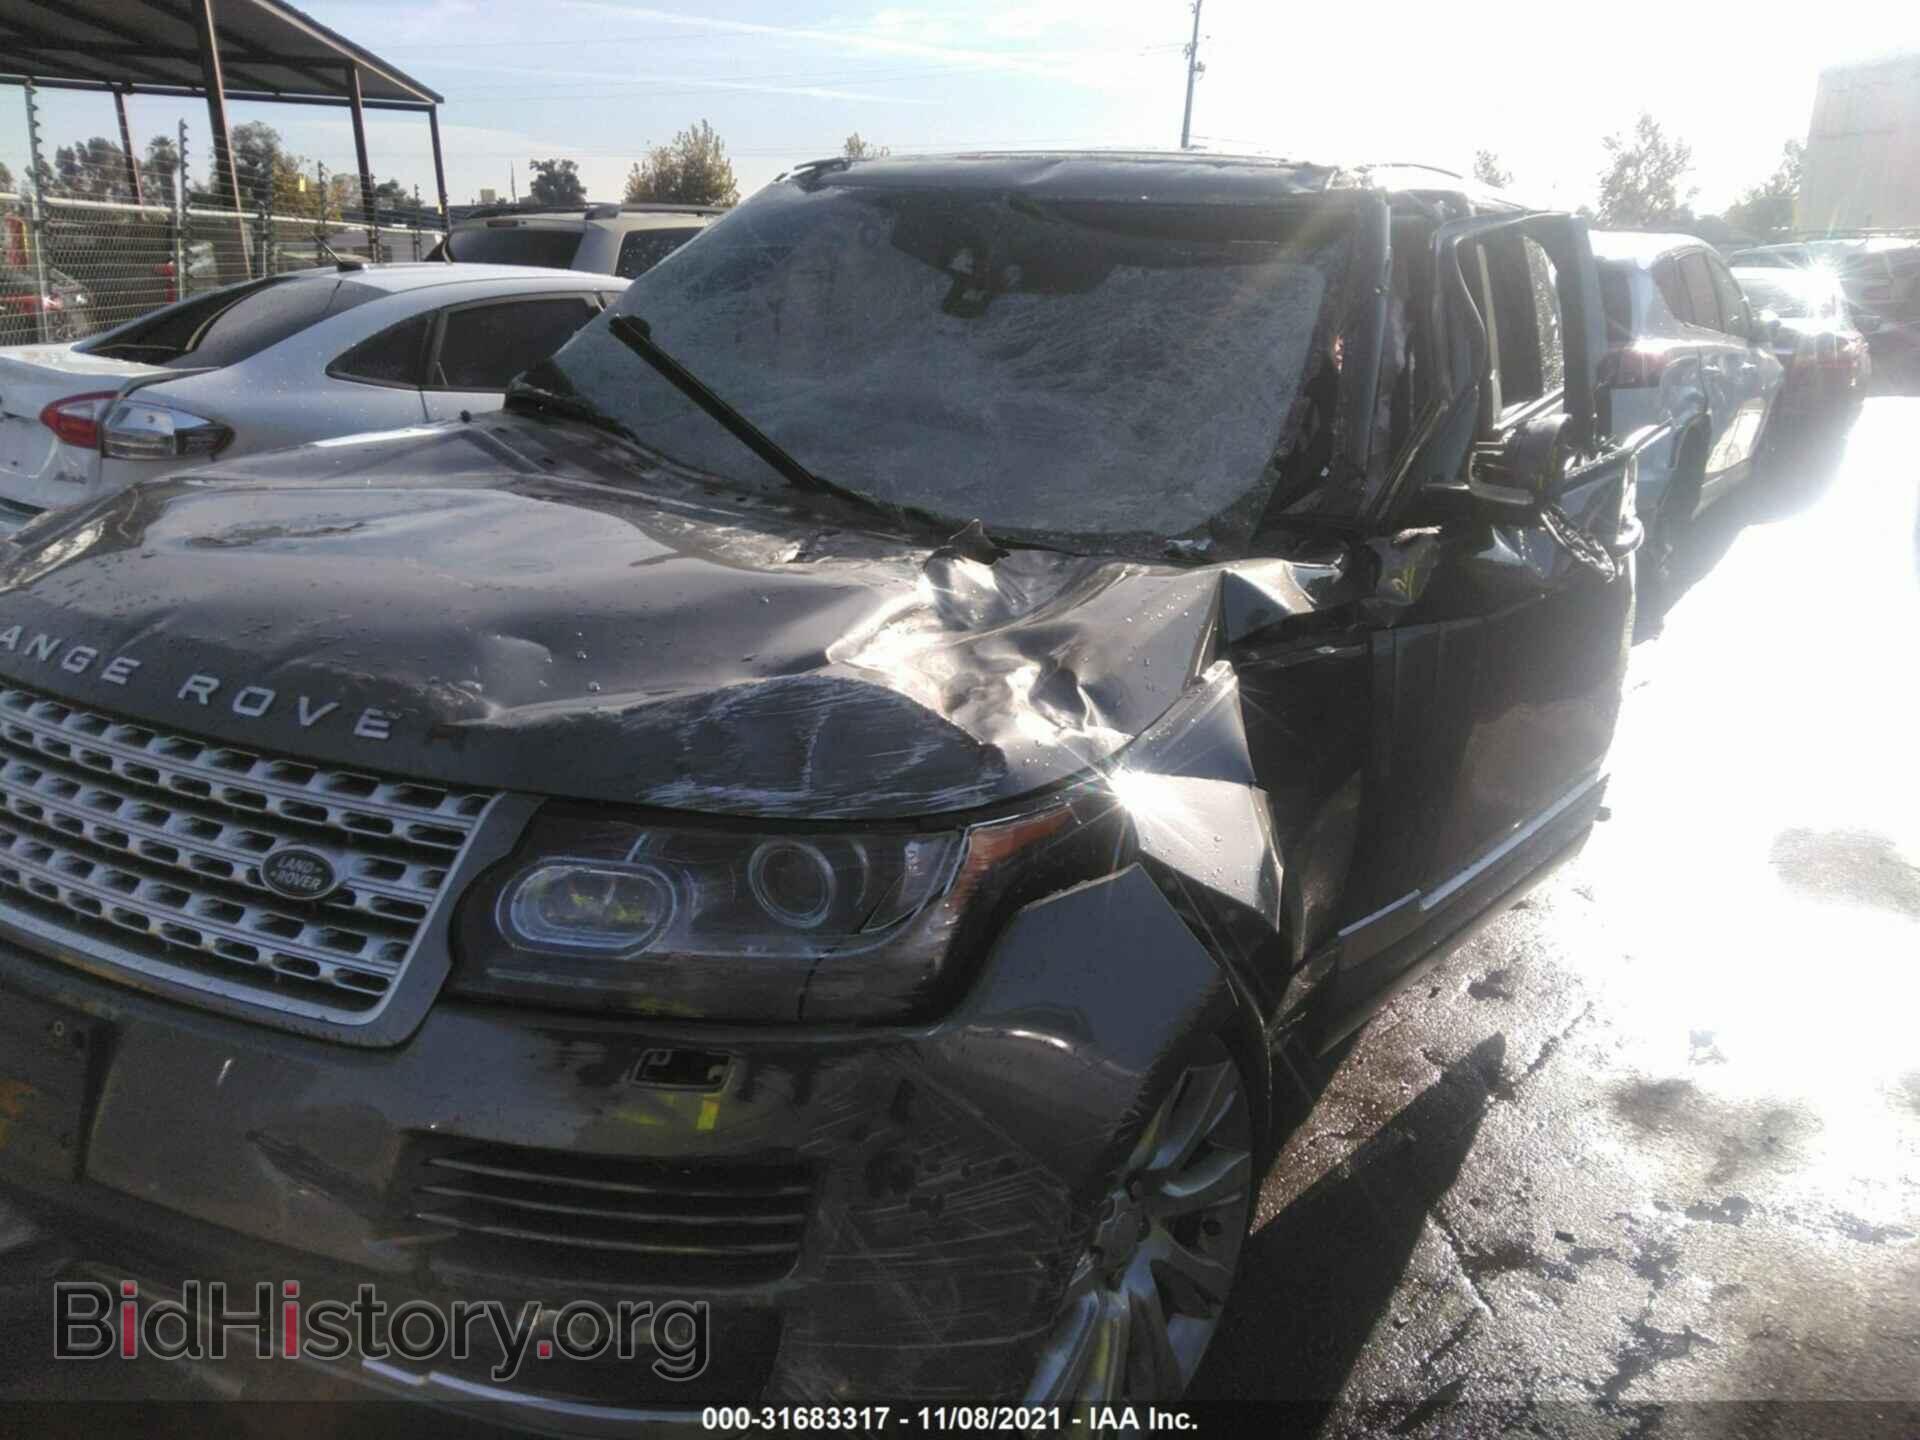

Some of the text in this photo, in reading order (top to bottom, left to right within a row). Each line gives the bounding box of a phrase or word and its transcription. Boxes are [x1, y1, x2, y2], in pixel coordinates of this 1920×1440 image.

[177, 674, 392, 740] ROVE
[277, 855, 315, 873] LAND
[277, 869, 322, 891] ROVER
